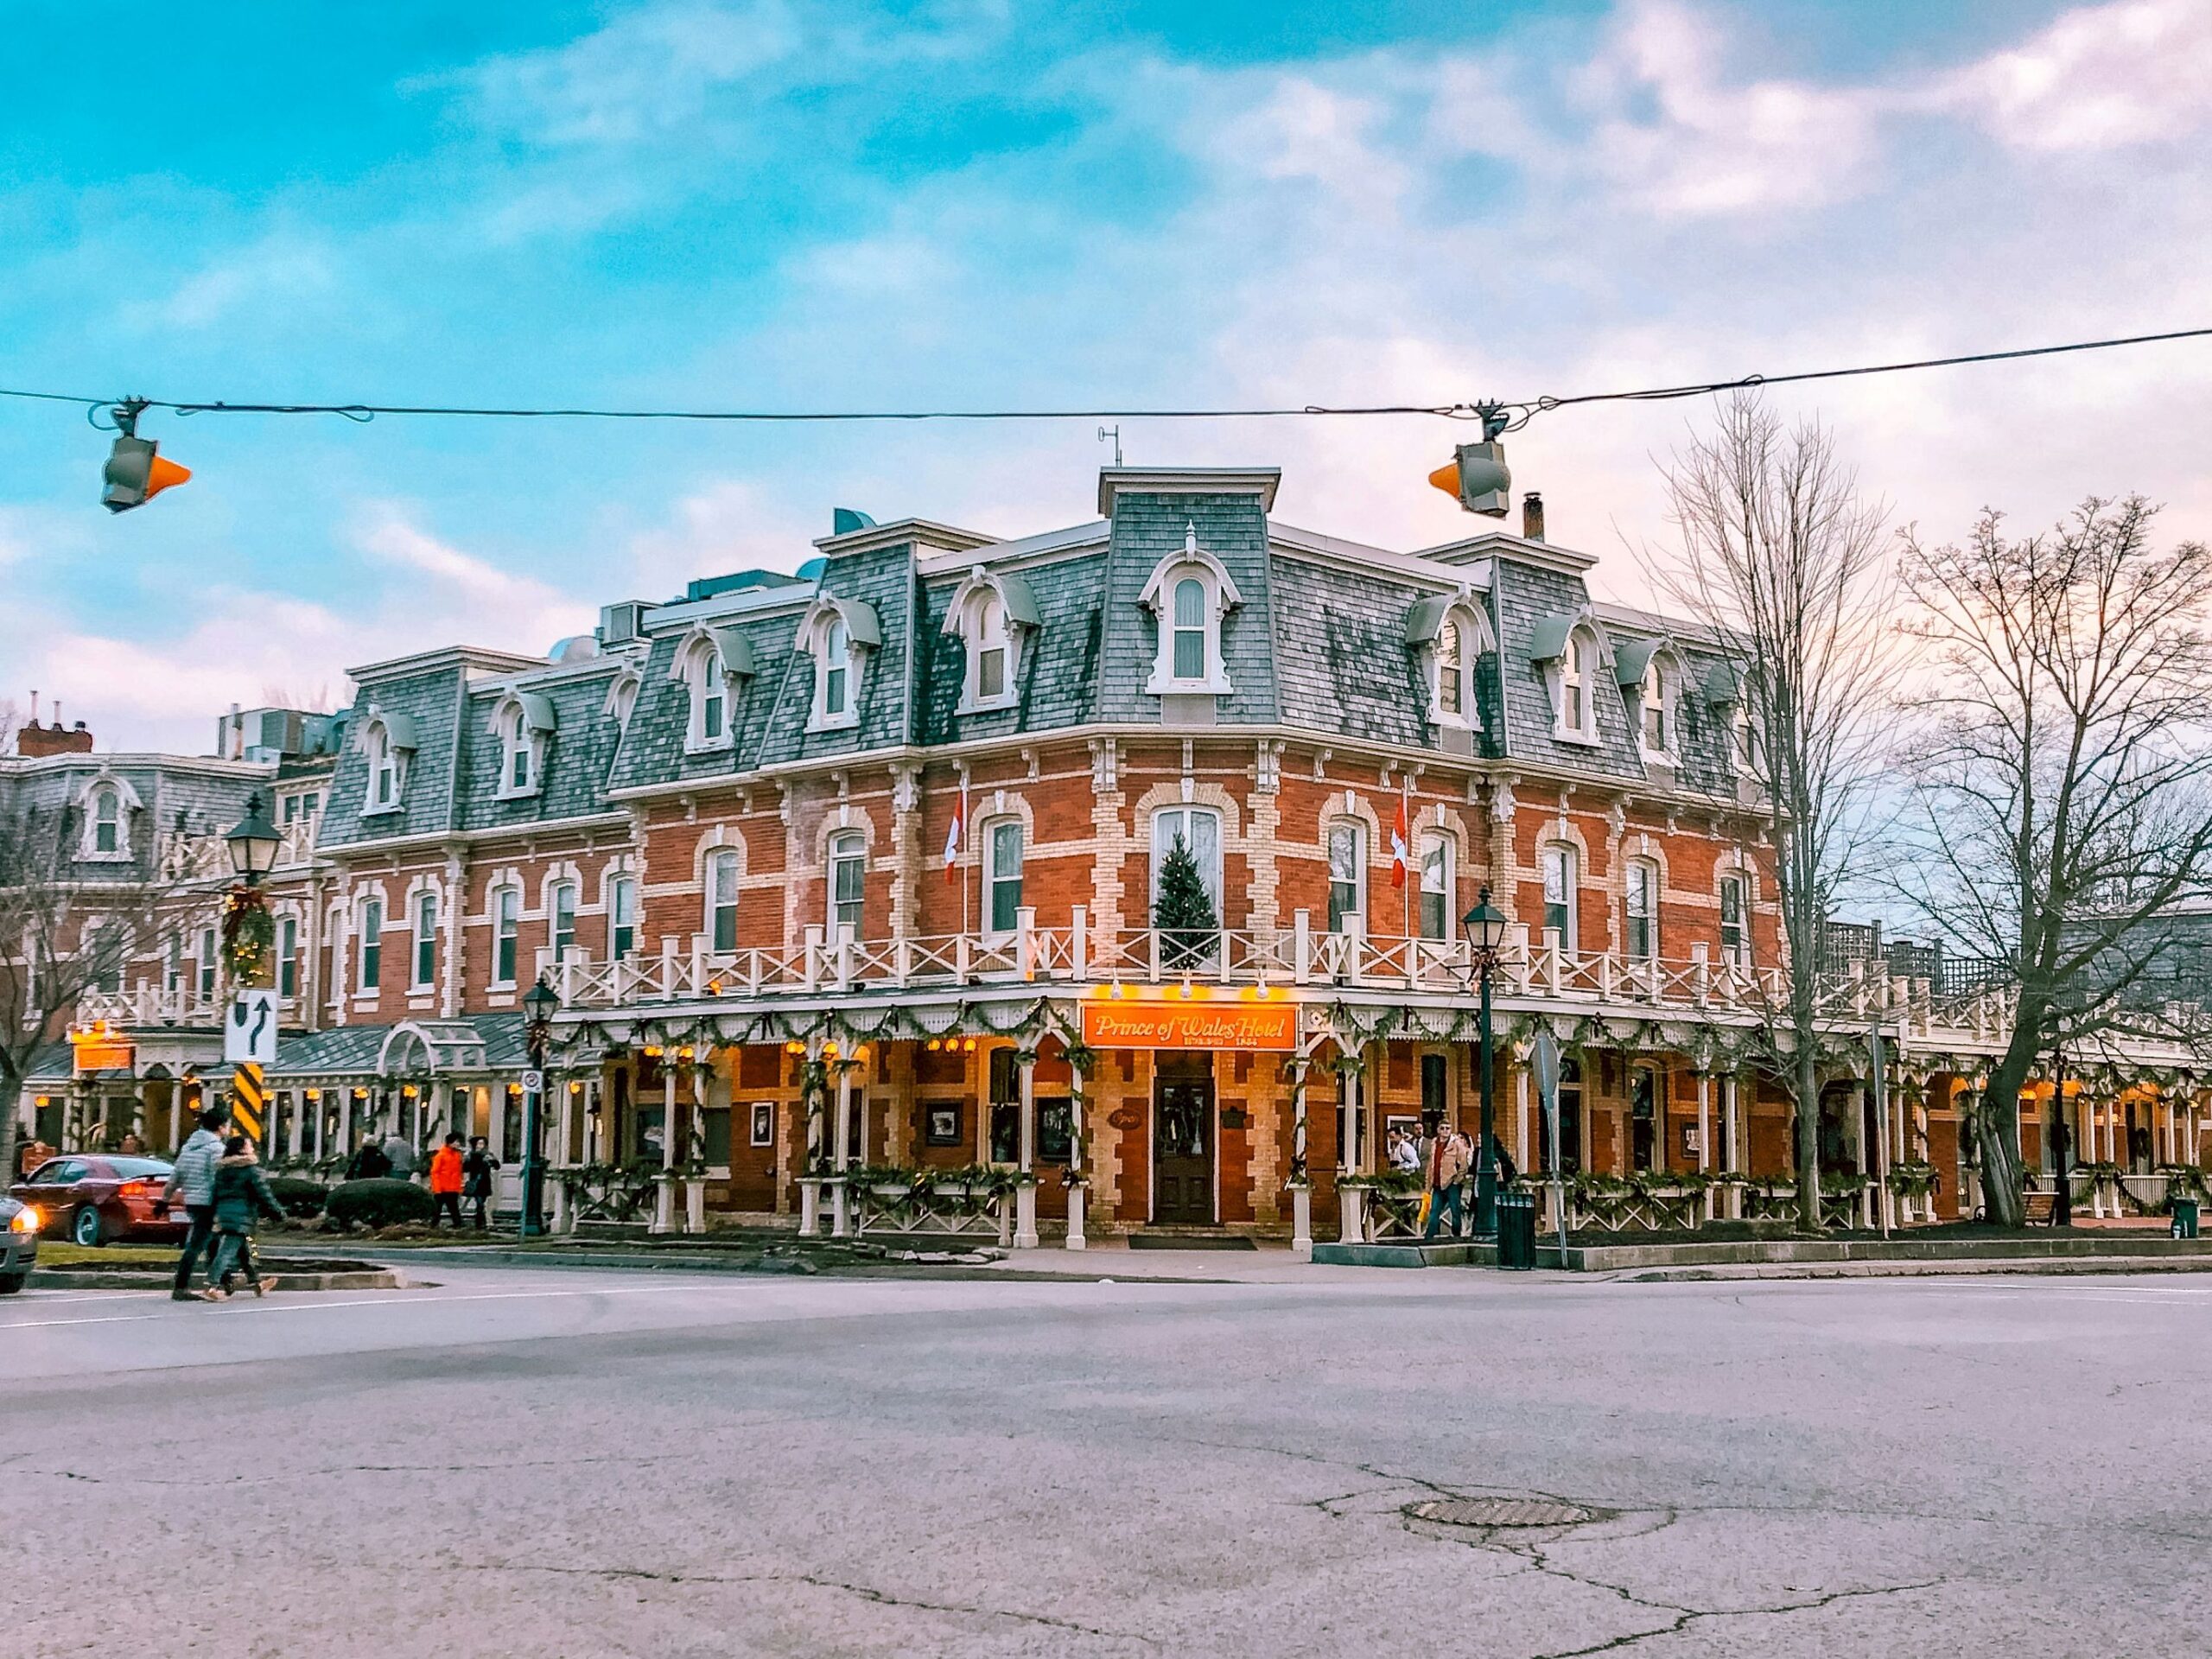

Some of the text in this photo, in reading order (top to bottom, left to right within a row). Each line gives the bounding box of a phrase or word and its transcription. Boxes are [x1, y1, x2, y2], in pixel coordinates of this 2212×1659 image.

[1095, 1015, 1286, 1041] Prince of Wales Hotel
